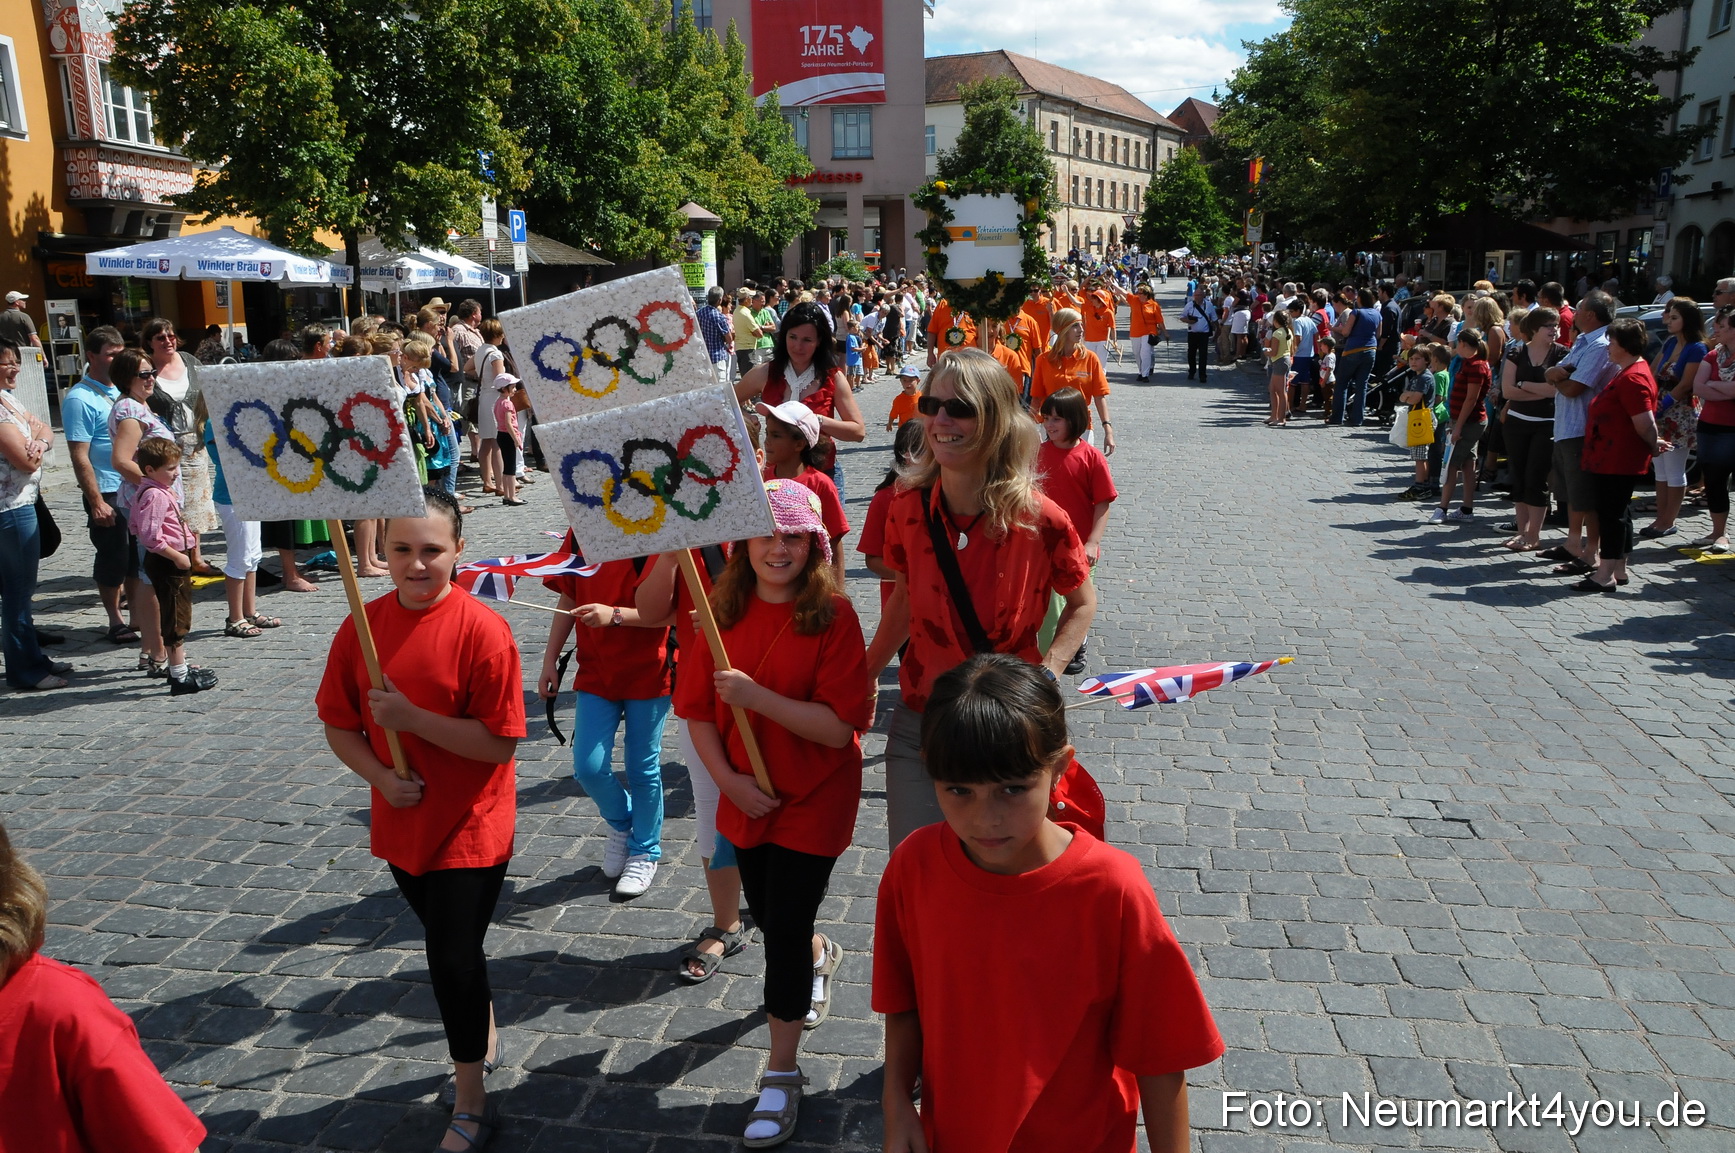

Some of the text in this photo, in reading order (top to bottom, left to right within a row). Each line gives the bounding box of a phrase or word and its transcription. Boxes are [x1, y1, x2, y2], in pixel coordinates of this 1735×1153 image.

[799, 25, 843, 44] 175
[801, 44, 844, 56] JAHRE
[785, 170, 863, 187] parkasse
[1660, 172, 1669, 195] P
[512, 214, 522, 239] P
[98, 257, 157, 269] Winkler Bräu
[197, 260, 259, 272] Winkler Bräu
[359, 267, 395, 276] nkler Bräu
[435, 267, 448, 277] Bräu
